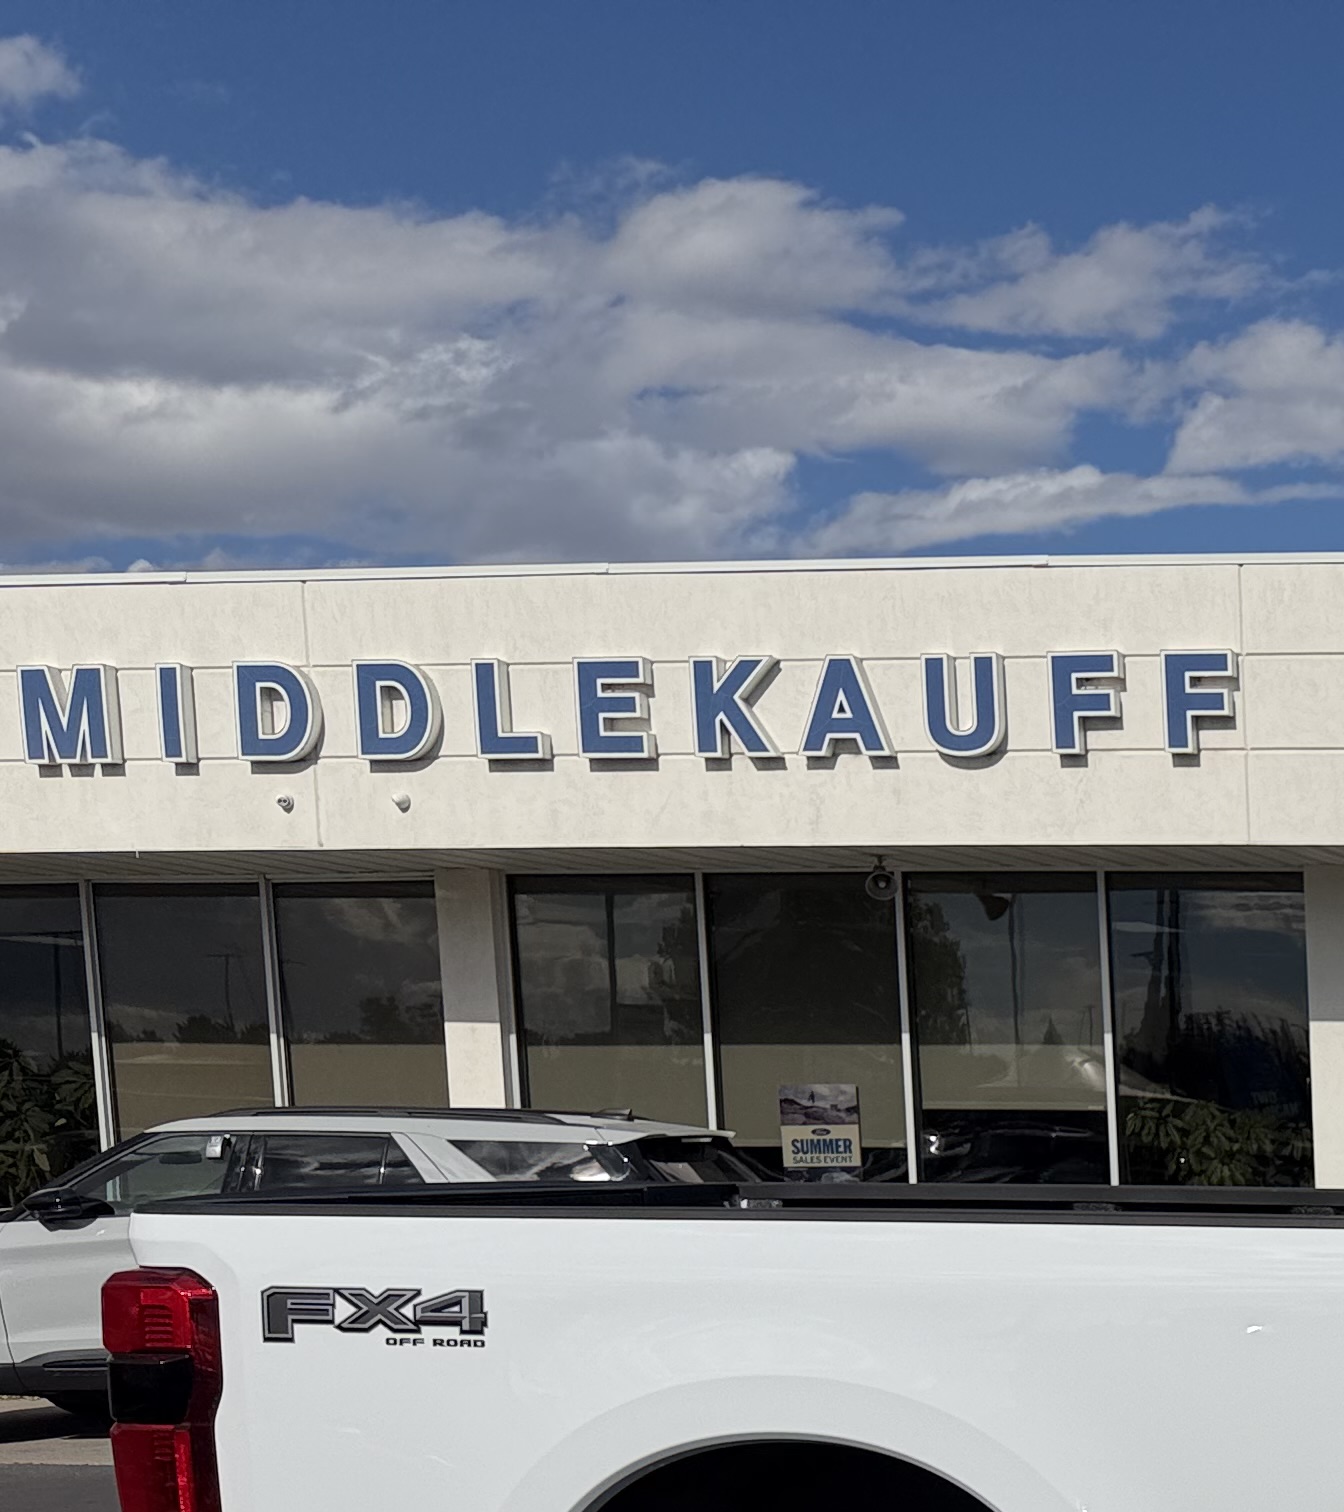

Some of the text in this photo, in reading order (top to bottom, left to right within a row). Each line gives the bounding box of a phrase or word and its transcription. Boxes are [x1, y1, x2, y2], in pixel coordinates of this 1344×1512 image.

[16, 649, 1239, 765] MIDDLEKAUFF
[791, 1138, 853, 1155] SUMMER
[793, 1156, 853, 1165] SALES EVENT
[261, 1286, 488, 1343] FX4
[385, 1337, 486, 1348] OFF ROAD
